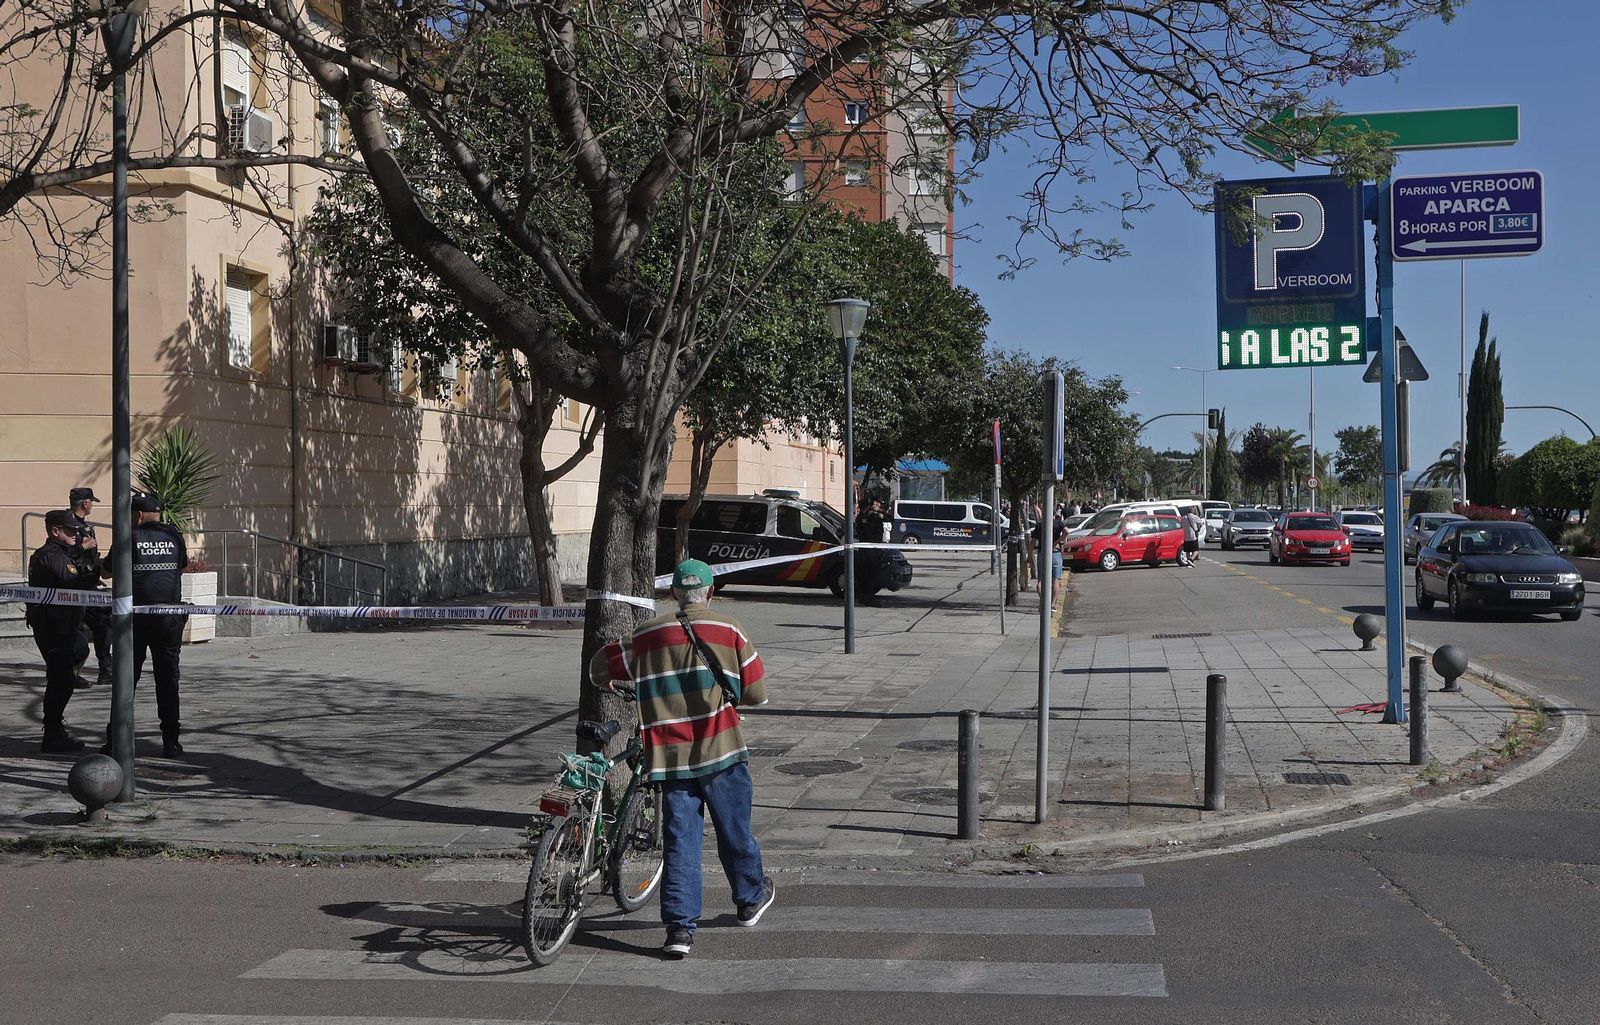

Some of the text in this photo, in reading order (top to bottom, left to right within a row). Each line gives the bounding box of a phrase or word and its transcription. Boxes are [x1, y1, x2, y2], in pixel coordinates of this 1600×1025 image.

[1400, 177, 1535, 196] PARKING VERBOOM
[1423, 197, 1511, 215] APARCA
[1399, 216, 1529, 235] 8 HORAS POR 3,80€
[1253, 192, 1325, 291] P
[1278, 273, 1352, 288] VERBOOM
[1241, 329, 1260, 365] A
[1271, 327, 1330, 364] LAS
[1340, 325, 1361, 361] 2
[136, 541, 175, 549] POLICIA
[141, 548, 173, 556] LOCAL
[413, 609, 436, 617] POLICIA
[437, 609, 446, 618] DE
[447, 609, 477, 618] NACIONAL
[508, 609, 539, 618] NO PASAR
[552, 609, 577, 618] POLICIA
